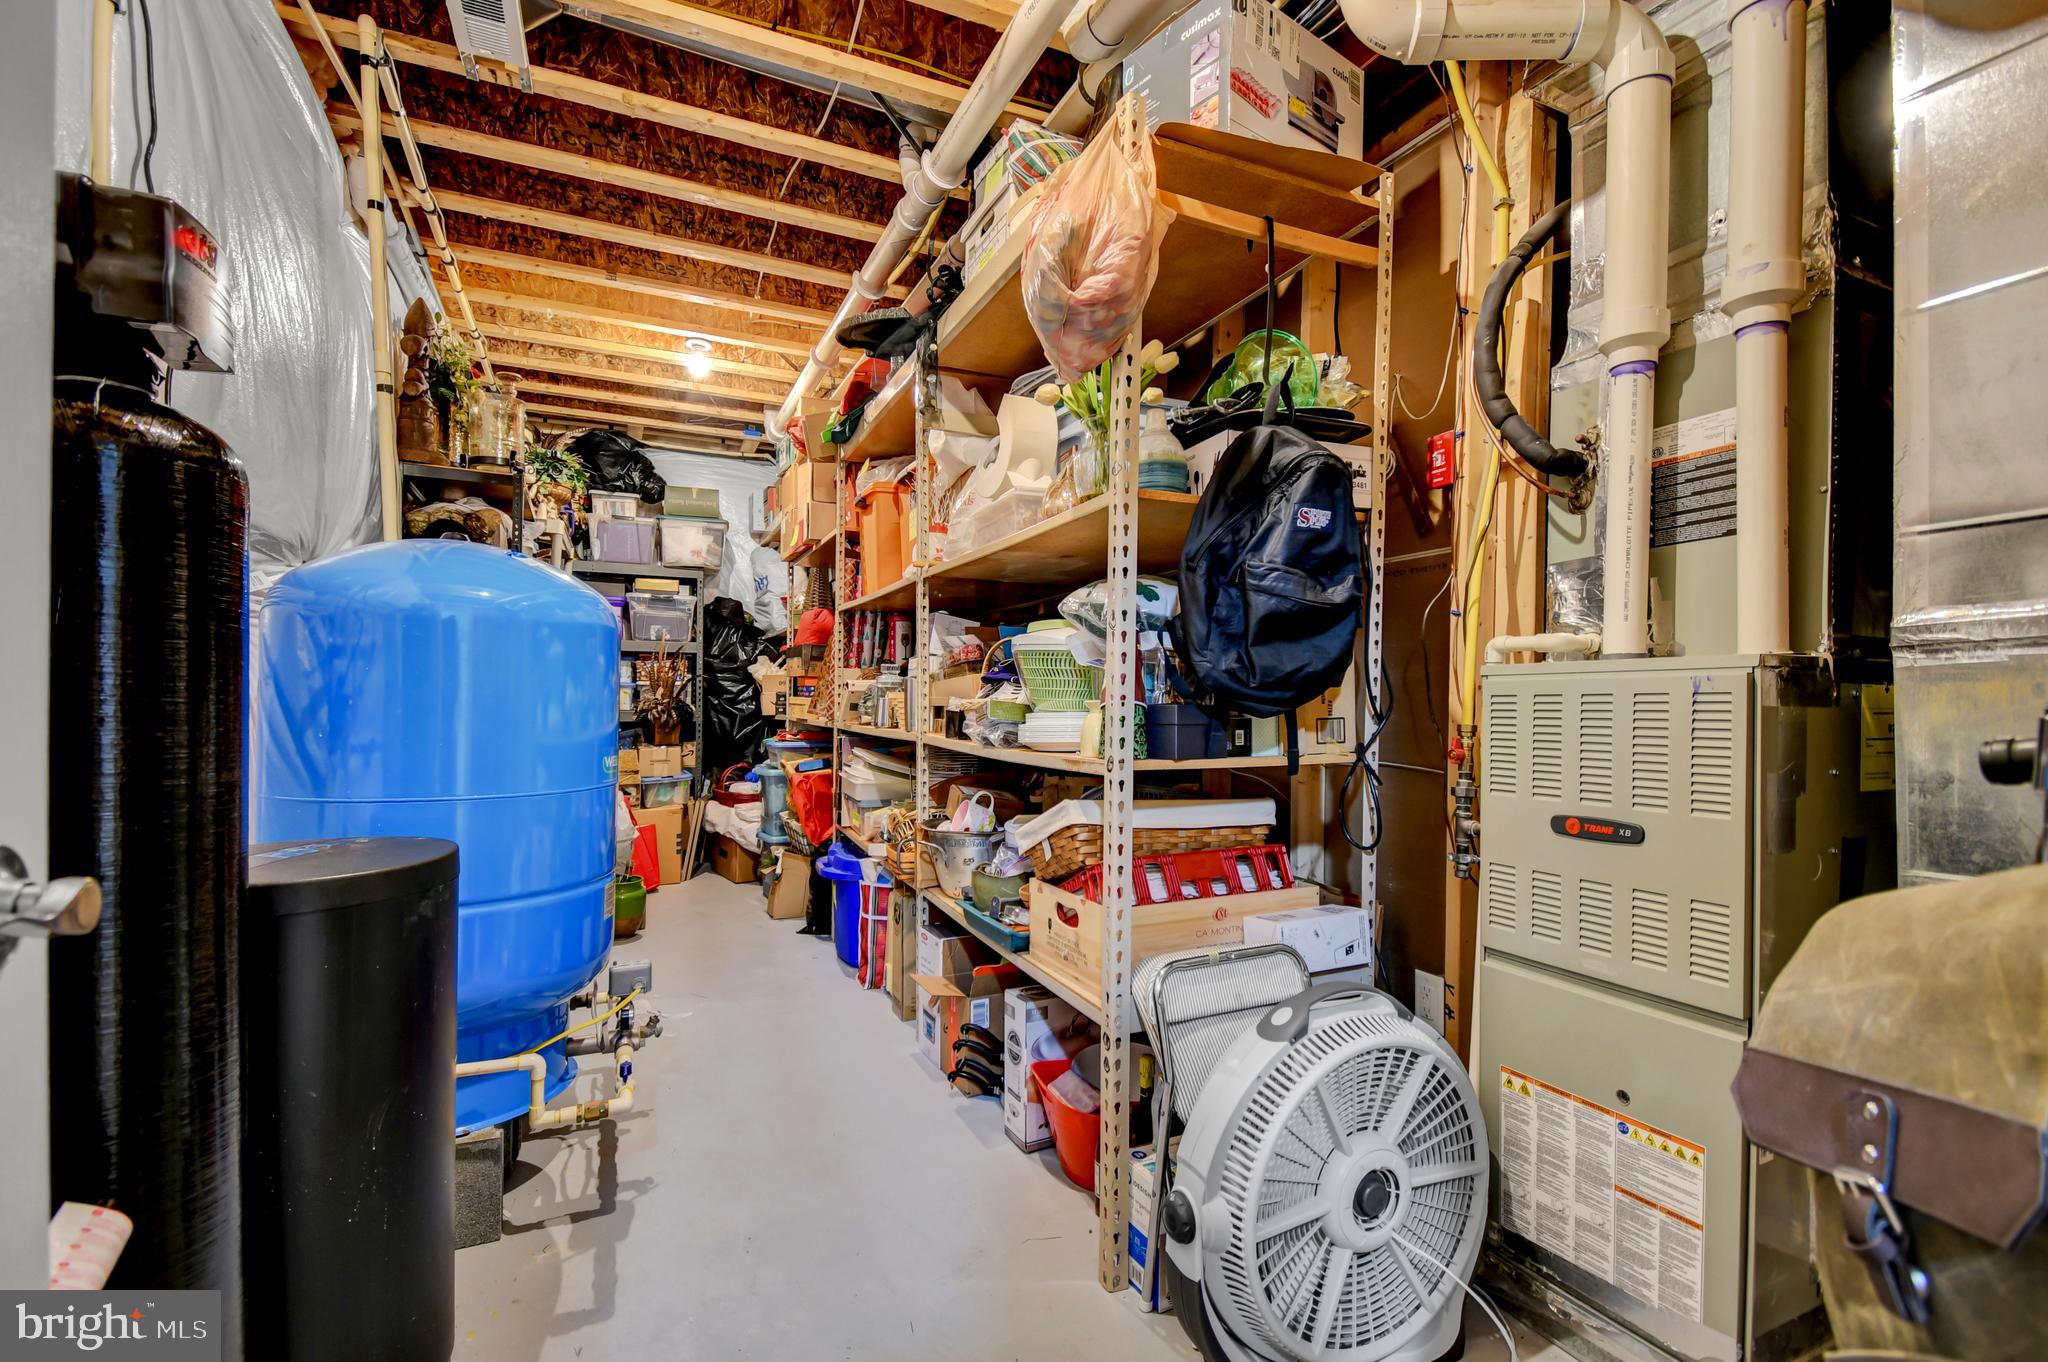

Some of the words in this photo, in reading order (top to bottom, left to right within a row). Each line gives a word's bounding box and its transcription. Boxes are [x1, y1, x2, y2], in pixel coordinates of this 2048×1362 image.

[1180, 6, 1222, 42] cusimax
[1624, 525, 1633, 569] CHARLOTTE
[1583, 823, 1615, 835] TRANE
[1619, 828, 1632, 837] XB
